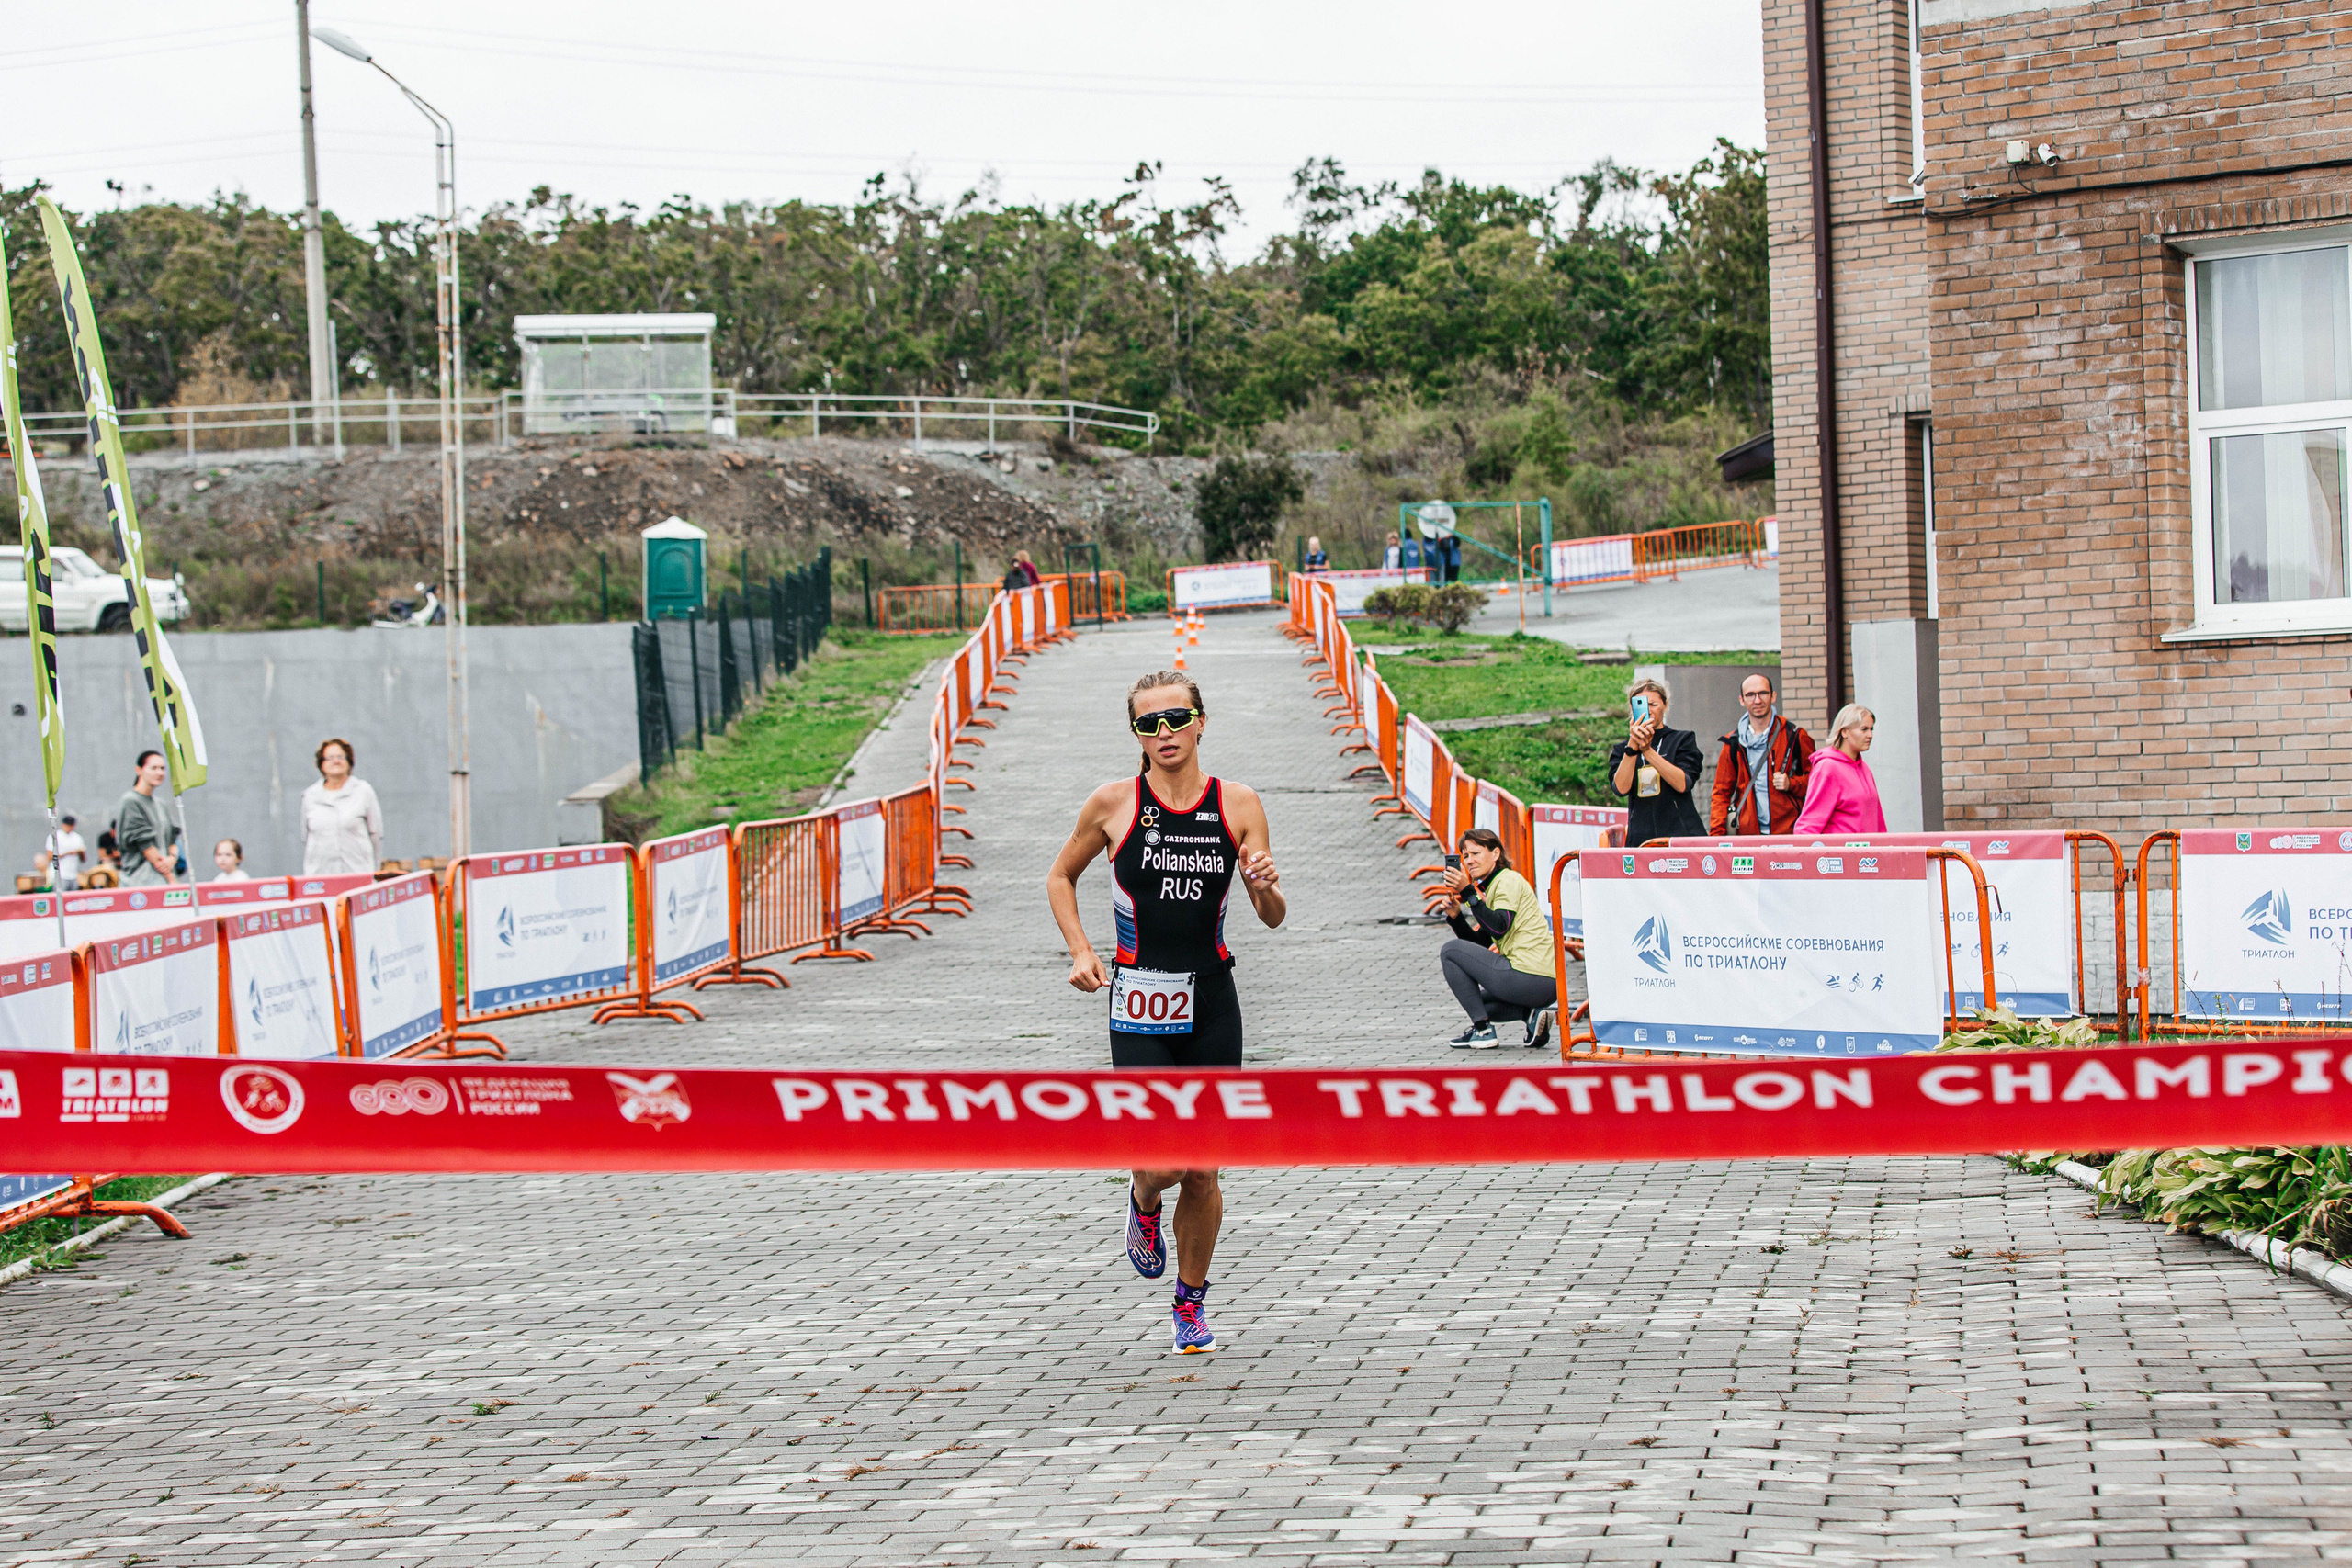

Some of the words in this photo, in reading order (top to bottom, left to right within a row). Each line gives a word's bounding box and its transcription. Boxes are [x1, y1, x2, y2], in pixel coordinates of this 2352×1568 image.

[1164, 835, 1221, 843] GAZPROMBANK
[1141, 846, 1224, 874] Polianskaia
[1159, 877, 1204, 900] RUS
[2309, 926, 2333, 939] ПО
[1682, 934, 1782, 950] ВСЕРОССИЙСКИЕ
[1786, 937, 1884, 952] СОРЕВНОВАНИЯ
[2241, 949, 2295, 959] ТРИАТЛОН
[1684, 954, 1703, 968] ПО
[1707, 955, 1787, 970] ТРИАТЛОНУ
[1634, 977, 1676, 988] ТРИАТЛОН
[1127, 989, 1190, 1021] 002
[1876, 1043, 1893, 1052] Helios
[774, 1078, 1273, 1122] PRIMORYE
[1317, 1068, 1874, 1118] TRIATHLON
[62, 1098, 169, 1113] TRIATHLON
